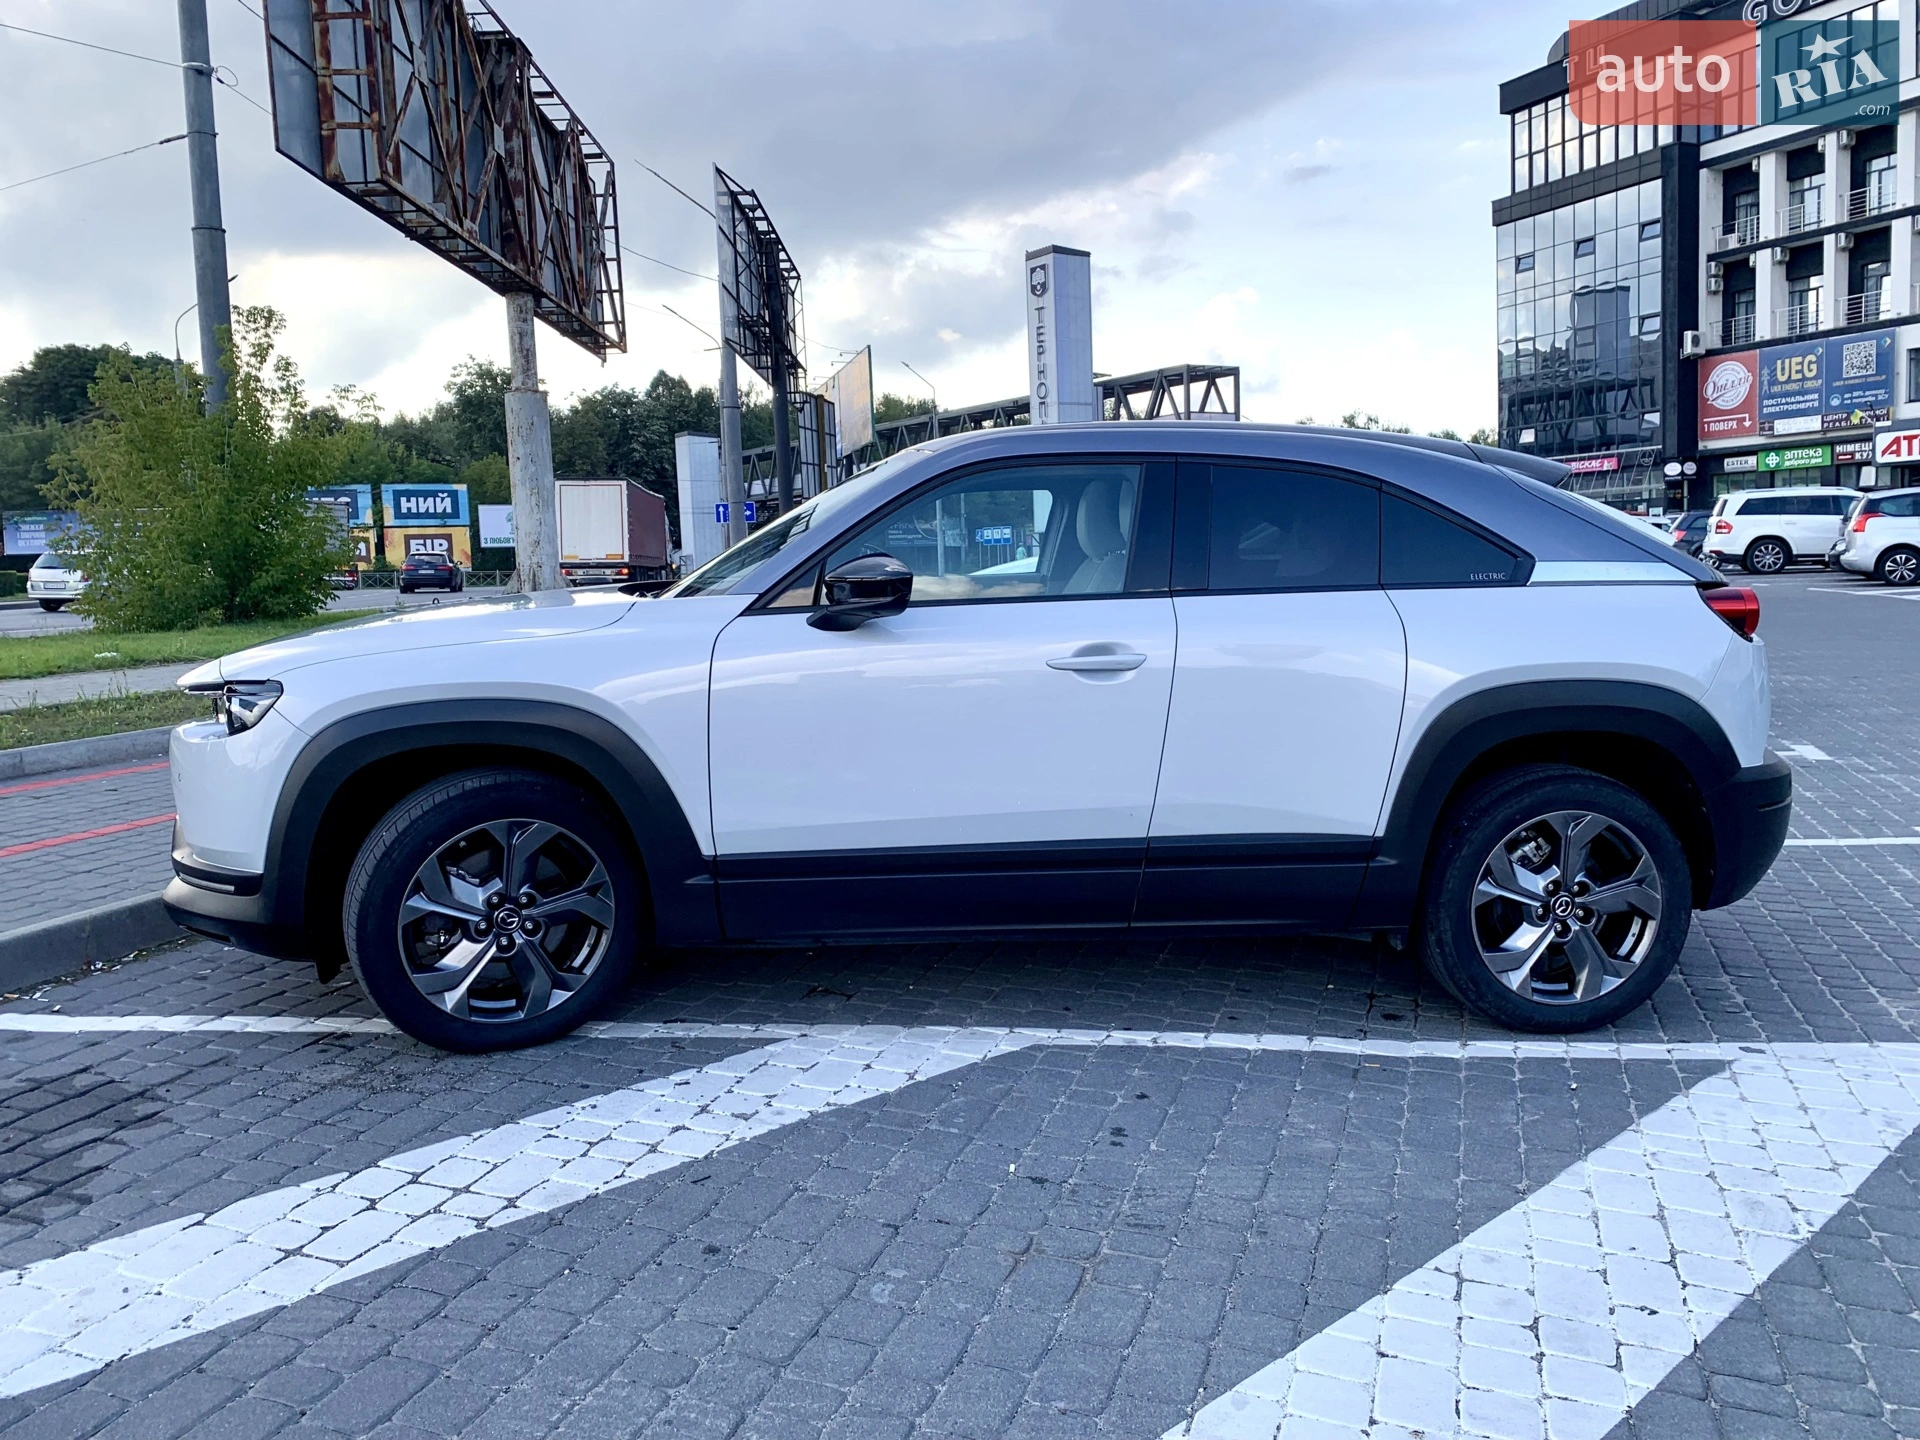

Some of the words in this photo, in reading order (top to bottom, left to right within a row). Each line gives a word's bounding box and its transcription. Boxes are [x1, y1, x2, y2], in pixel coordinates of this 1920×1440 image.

[1034, 306, 1049, 424] ТЕРНОП
[1776, 354, 1818, 382] UEG
[1782, 381, 1803, 391] ENERGY
[1803, 379, 1823, 389] GROUP
[1763, 393, 1819, 407] ПОСТАЧАЛЬНИК
[1763, 400, 1819, 414] ЕЛЕКТРОЕНЕРГІЇ
[1823, 413, 1848, 422] ЦЕНТР
[1704, 424, 1708, 432] 1
[1709, 421, 1738, 432] ПОВЕРХ
[1881, 434, 1920, 458] АТ
[1784, 447, 1822, 460] аптека
[1784, 459, 1809, 467] доброго
[400, 493, 452, 514] НИЙ
